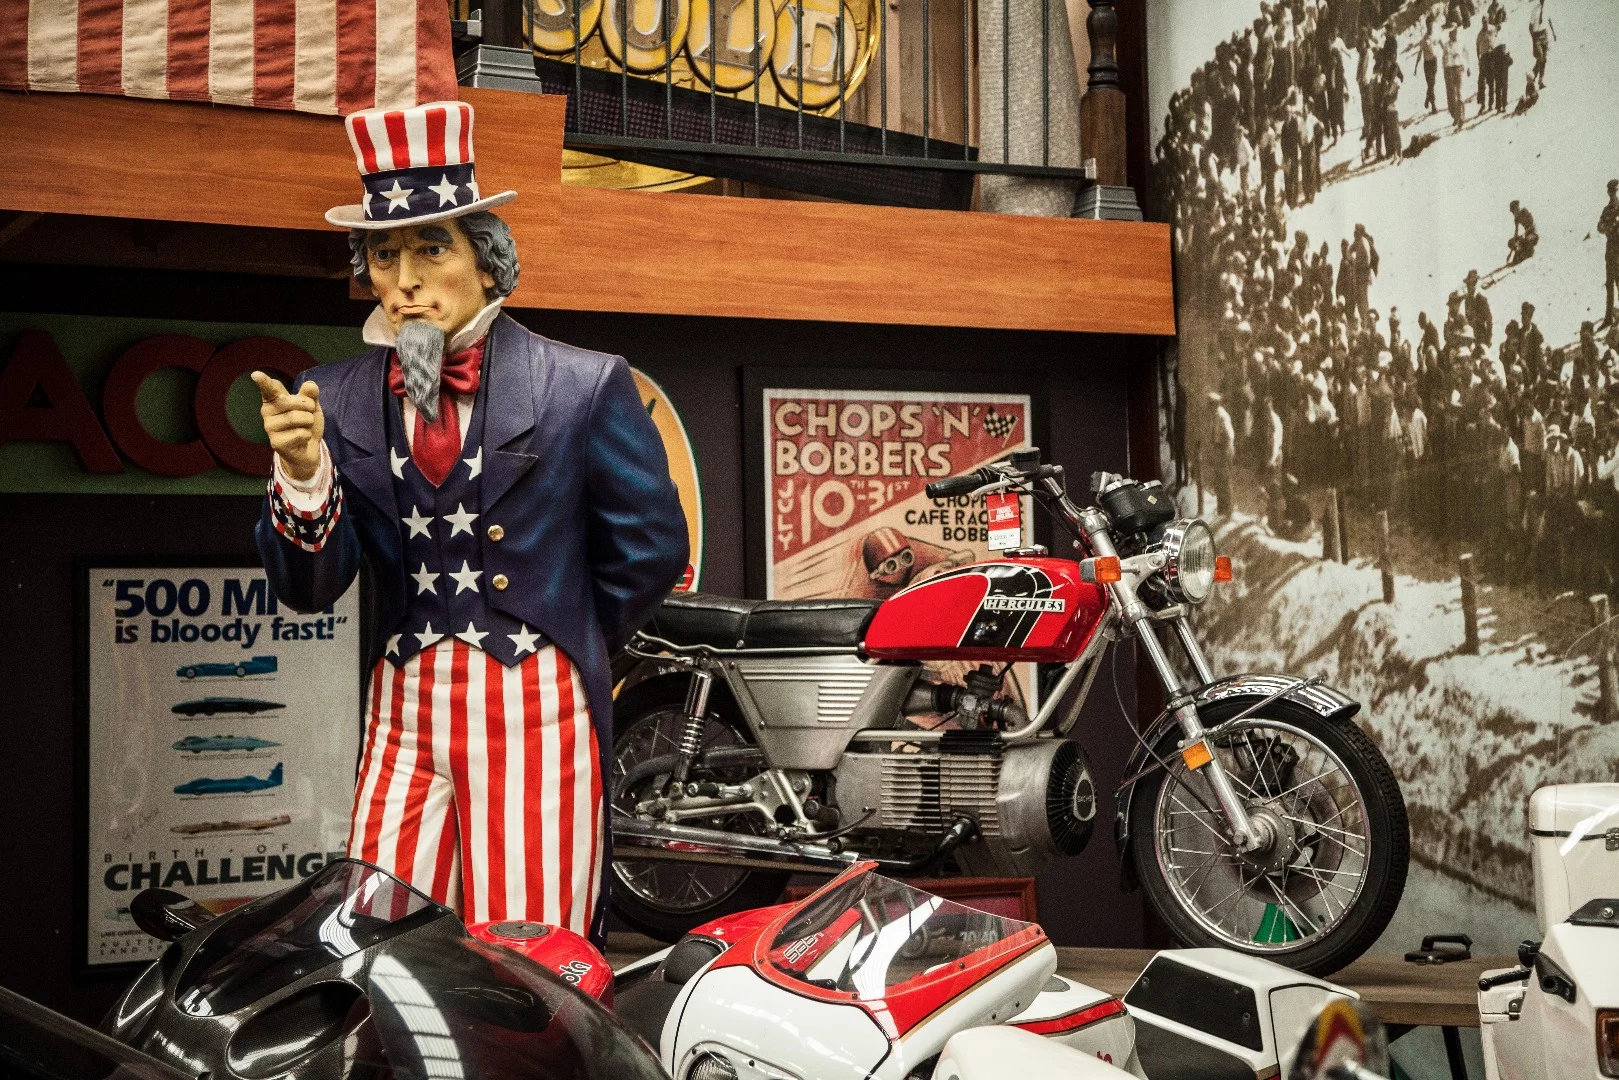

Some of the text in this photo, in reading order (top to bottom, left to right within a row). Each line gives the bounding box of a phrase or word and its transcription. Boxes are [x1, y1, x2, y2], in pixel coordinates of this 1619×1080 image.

[775, 402, 923, 438] CHOPS
[775, 440, 951, 477] BOBBERS
[777, 480, 794, 551] JULY
[905, 509, 948, 525] CAFE
[986, 598, 1062, 612] HERCULES
[115, 620, 139, 644] is
[150, 617, 261, 649] bloody
[104, 848, 205, 863] BIRTH
[257, 843, 289, 854] OF
